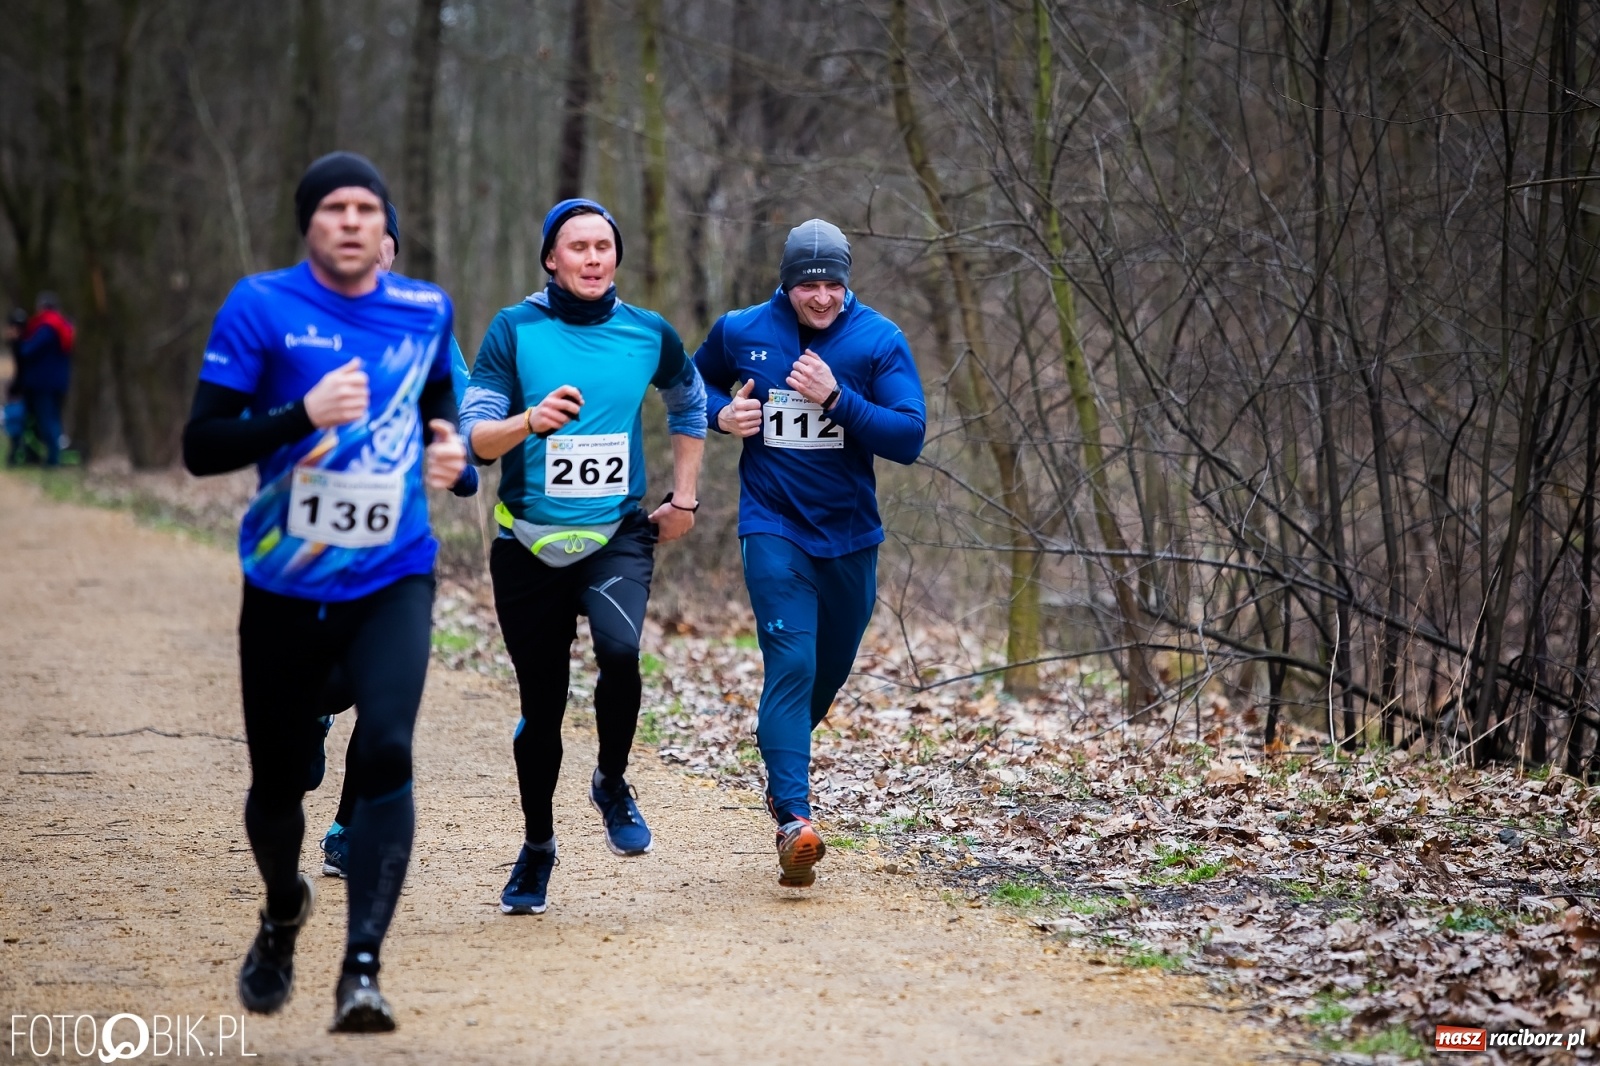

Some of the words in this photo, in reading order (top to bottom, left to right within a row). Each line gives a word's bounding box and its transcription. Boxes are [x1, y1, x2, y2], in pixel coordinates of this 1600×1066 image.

[769, 411, 839, 438] 112
[551, 457, 624, 485] 262
[300, 496, 390, 531] 136
